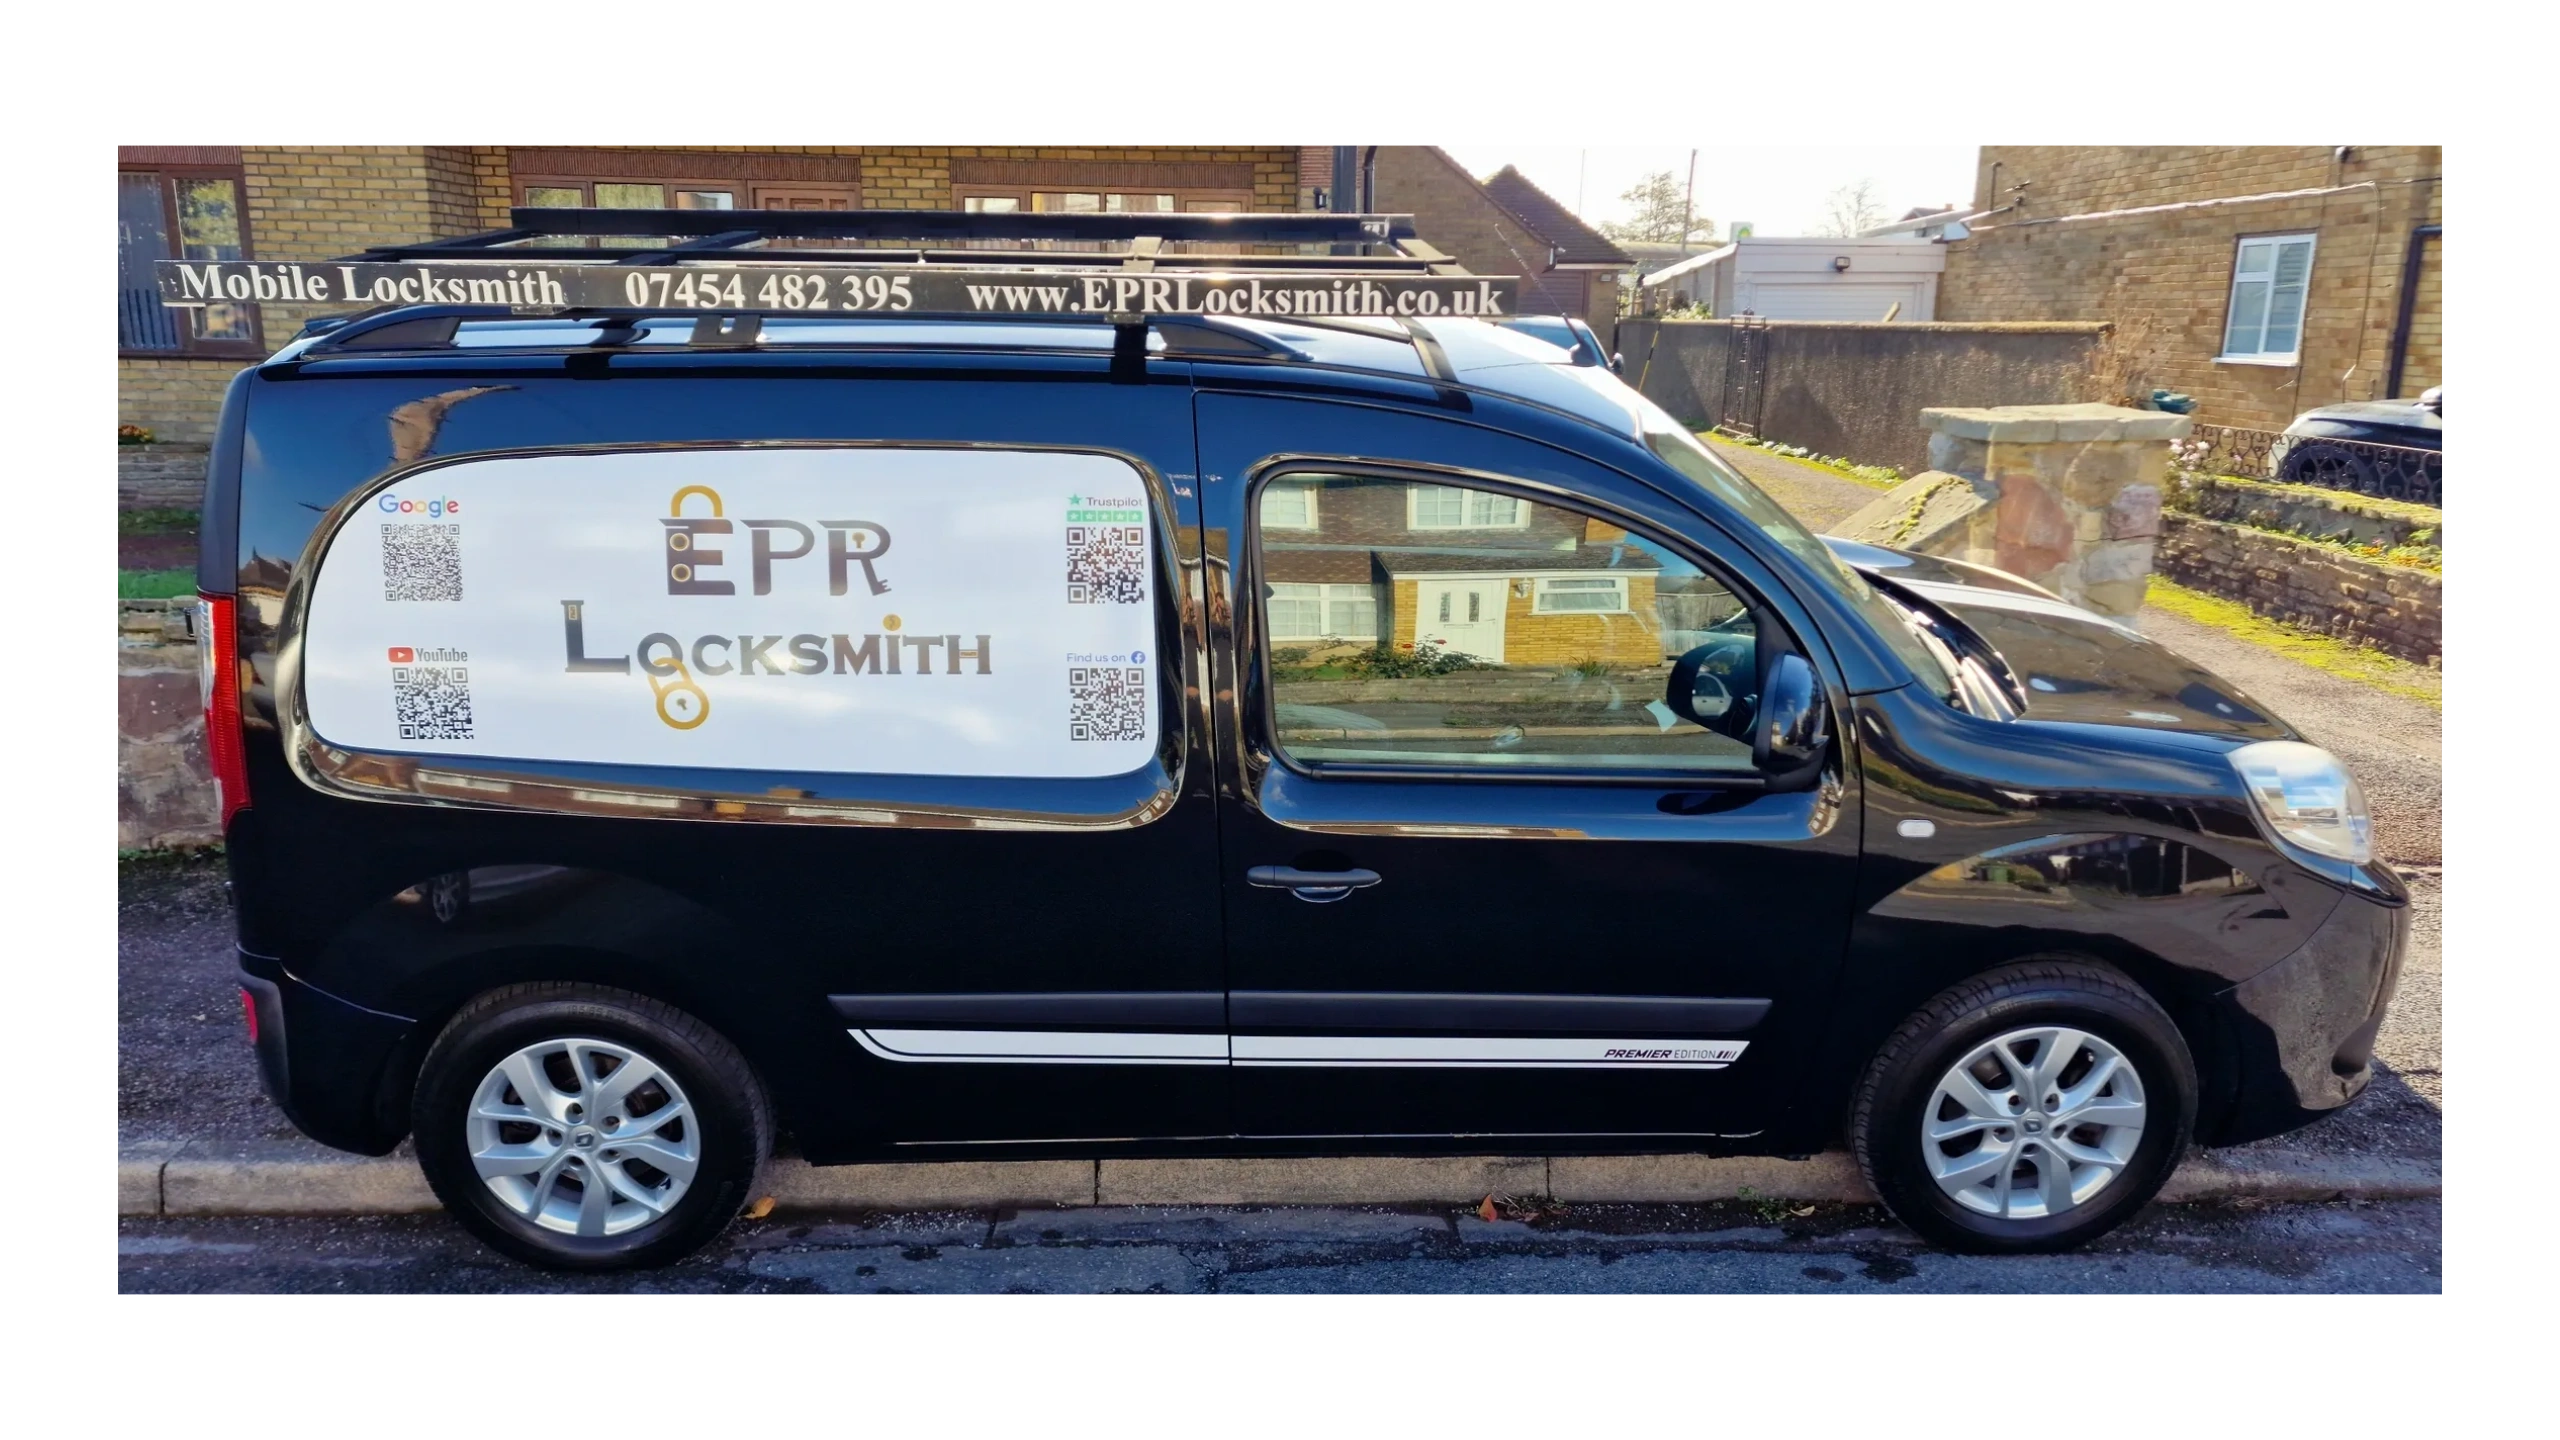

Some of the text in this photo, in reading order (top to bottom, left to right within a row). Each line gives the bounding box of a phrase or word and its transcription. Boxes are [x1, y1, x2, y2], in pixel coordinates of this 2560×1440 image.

[175, 264, 1503, 317] Mobile Locksmith 07454 482 395 www.EPRLocksmith.co.uk
[379, 494, 459, 518] Google
[1086, 497, 1142, 508] Trustpilot
[658, 517, 892, 597] EPR
[415, 648, 468, 662] YouTube
[1066, 652, 1092, 662] Find
[1604, 1049, 1717, 1059] PREMIER EDITION
